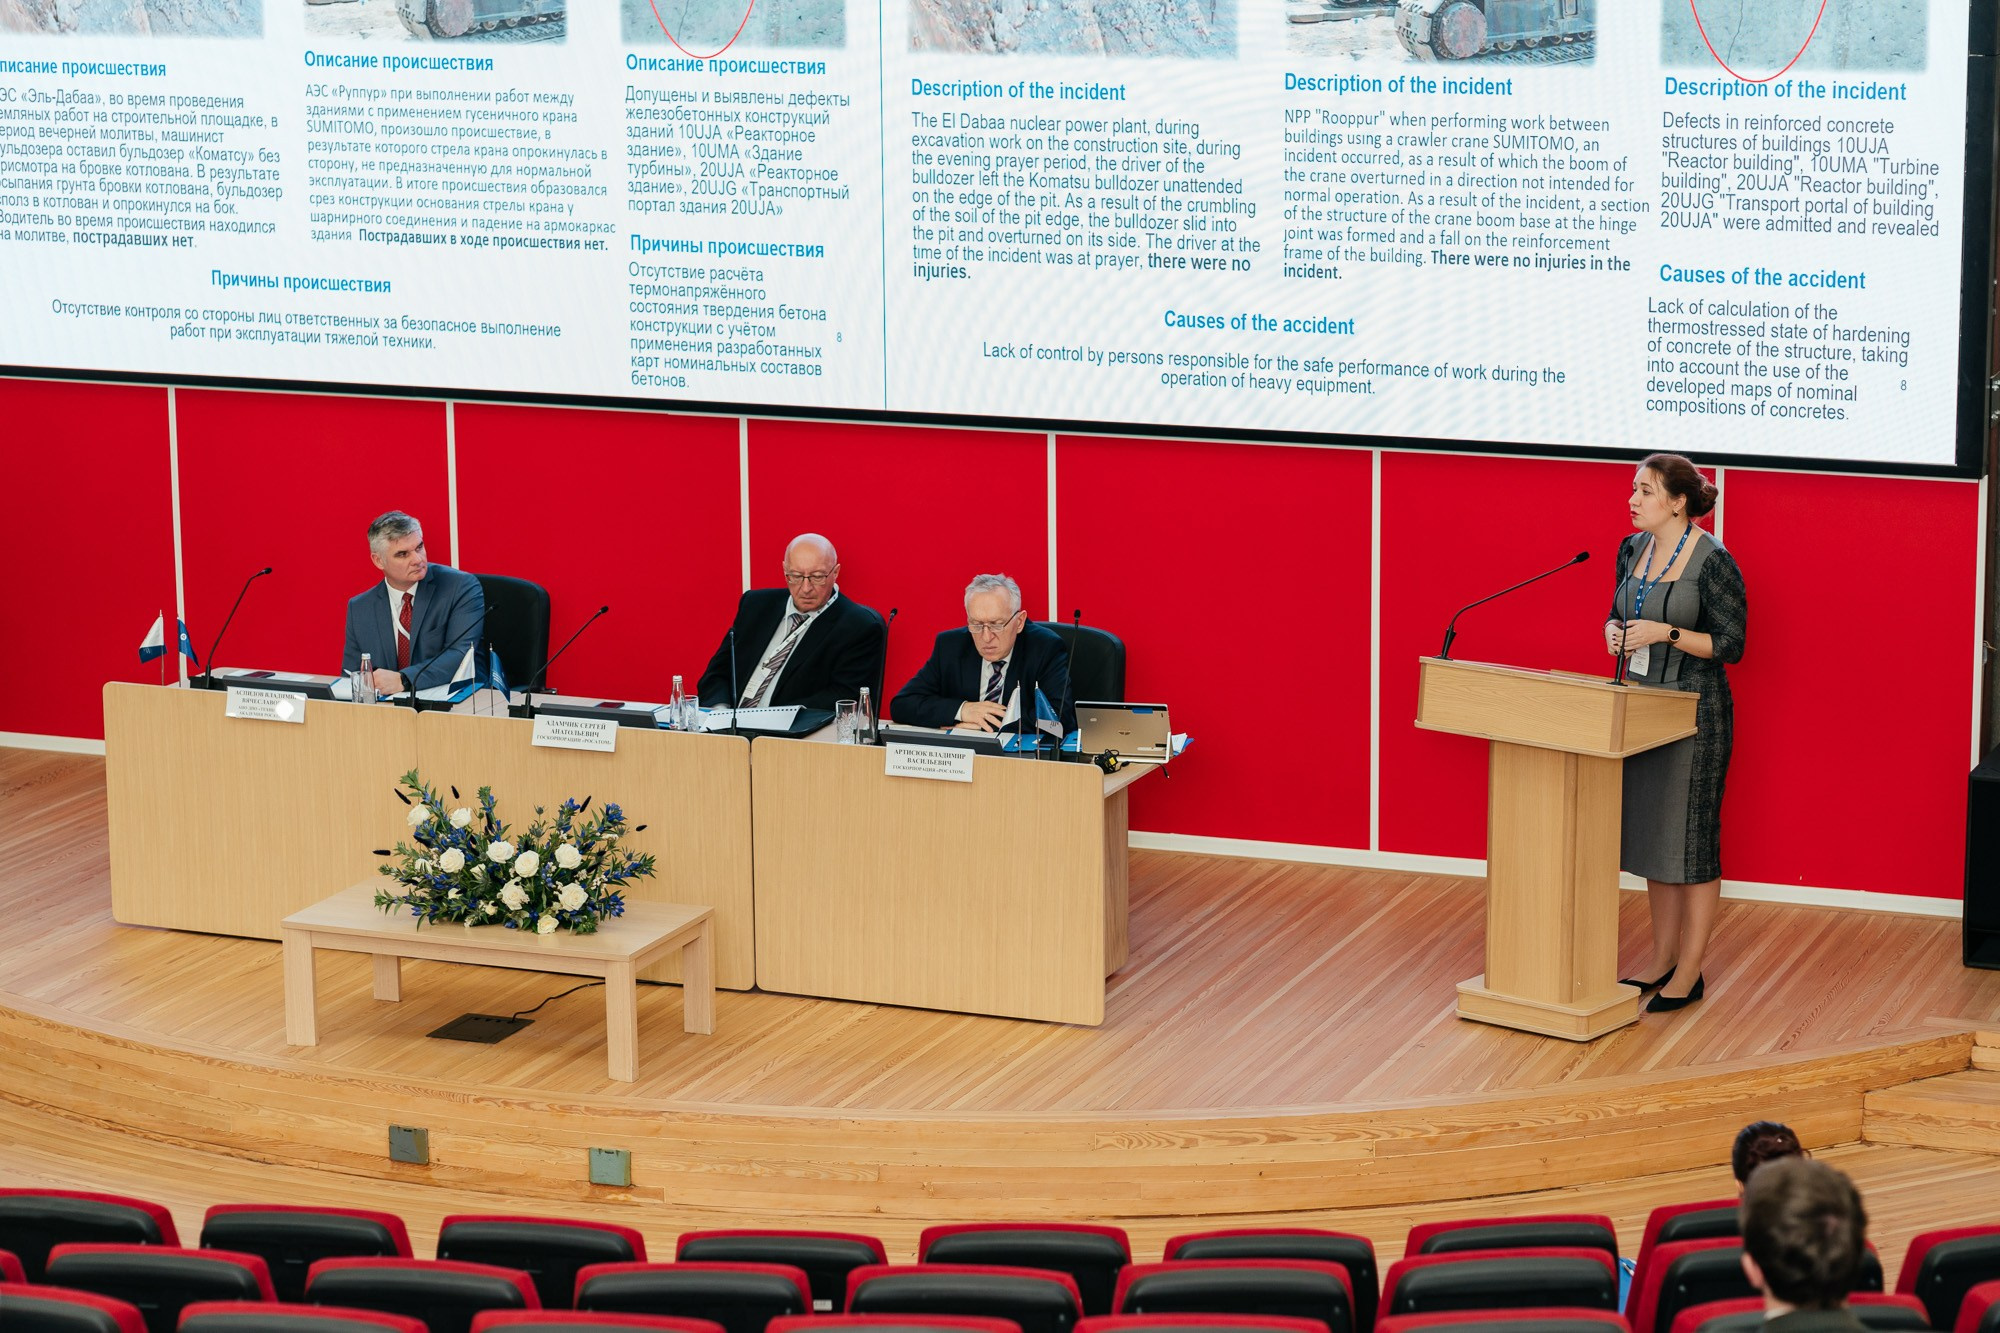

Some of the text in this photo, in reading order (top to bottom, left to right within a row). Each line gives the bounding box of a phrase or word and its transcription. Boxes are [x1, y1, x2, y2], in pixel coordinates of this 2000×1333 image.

[62, 62, 166, 77] происшествия
[304, 50, 493, 72] Описание происшествия
[626, 53, 825, 76] Описание происшествия
[305, 83, 574, 107] АЭС «Руппур» при выполнении работ между
[912, 78, 1125, 100] Description of the incident
[1285, 72, 1512, 96] Description of the incident
[1665, 76, 1906, 100] Description of the incident
[21, 88, 244, 110] «Эль-Дабаа», во время проведения
[625, 85, 850, 109] Допущены и выявлены дефекты
[306, 119, 551, 141] SUMITOMO, произошло происшествие, в
[911, 111, 1199, 139] The El Dabaa nuclear power plant, during
[1285, 108, 1609, 132] NPP "Rooppur" when performing work between
[1663, 111, 1894, 133] Defects in reinforced concrete
[627, 123, 673, 139] зданий
[727, 125, 815, 145] «Реакторное
[1662, 133, 1737, 150] structures
[1742, 134, 1758, 150] of
[1762, 134, 1830, 155] buildings
[66, 143, 280, 165] оставил бульдозер «Коматсу» без
[309, 176, 606, 197] эксплуатации. В итоге происшествия образовался
[912, 168, 1242, 194] bulldozer left the Komatsu bulldozer unattended
[628, 199, 675, 214] портал
[679, 201, 726, 215] здания
[15, 230, 197, 247] молитве, пострадавших нет.
[311, 228, 608, 250] здания Пострадавших в ходе происшествия нет.
[631, 234, 824, 258] Причины происшествия
[211, 269, 390, 293] Причины происшествия
[628, 261, 763, 283] Отсутствие расчёта
[913, 261, 971, 281] injuries.
[1284, 262, 1342, 279] incident.
[1660, 264, 1865, 289] Causes of the accident
[629, 283, 766, 301] термонапряжённого
[52, 299, 560, 336] Отсутствие контроля со стороны лиц ответственных за безопасное выполнение
[1648, 296, 1837, 320] Lack of calculation of the
[630, 320, 775, 339] конструкции с учётом
[1164, 310, 1354, 335] Causes of the accident
[170, 322, 206, 339] работ
[209, 327, 231, 341] при
[235, 329, 320, 345] эксплуатации
[382, 335, 435, 348] техники.
[836, 331, 842, 343] 8
[631, 370, 689, 388] бетонов.
[1161, 371, 1375, 395] operation of heavy equipment.
[1900, 379, 1907, 391] 8
[1646, 397, 1848, 420] compositions of concretes.
